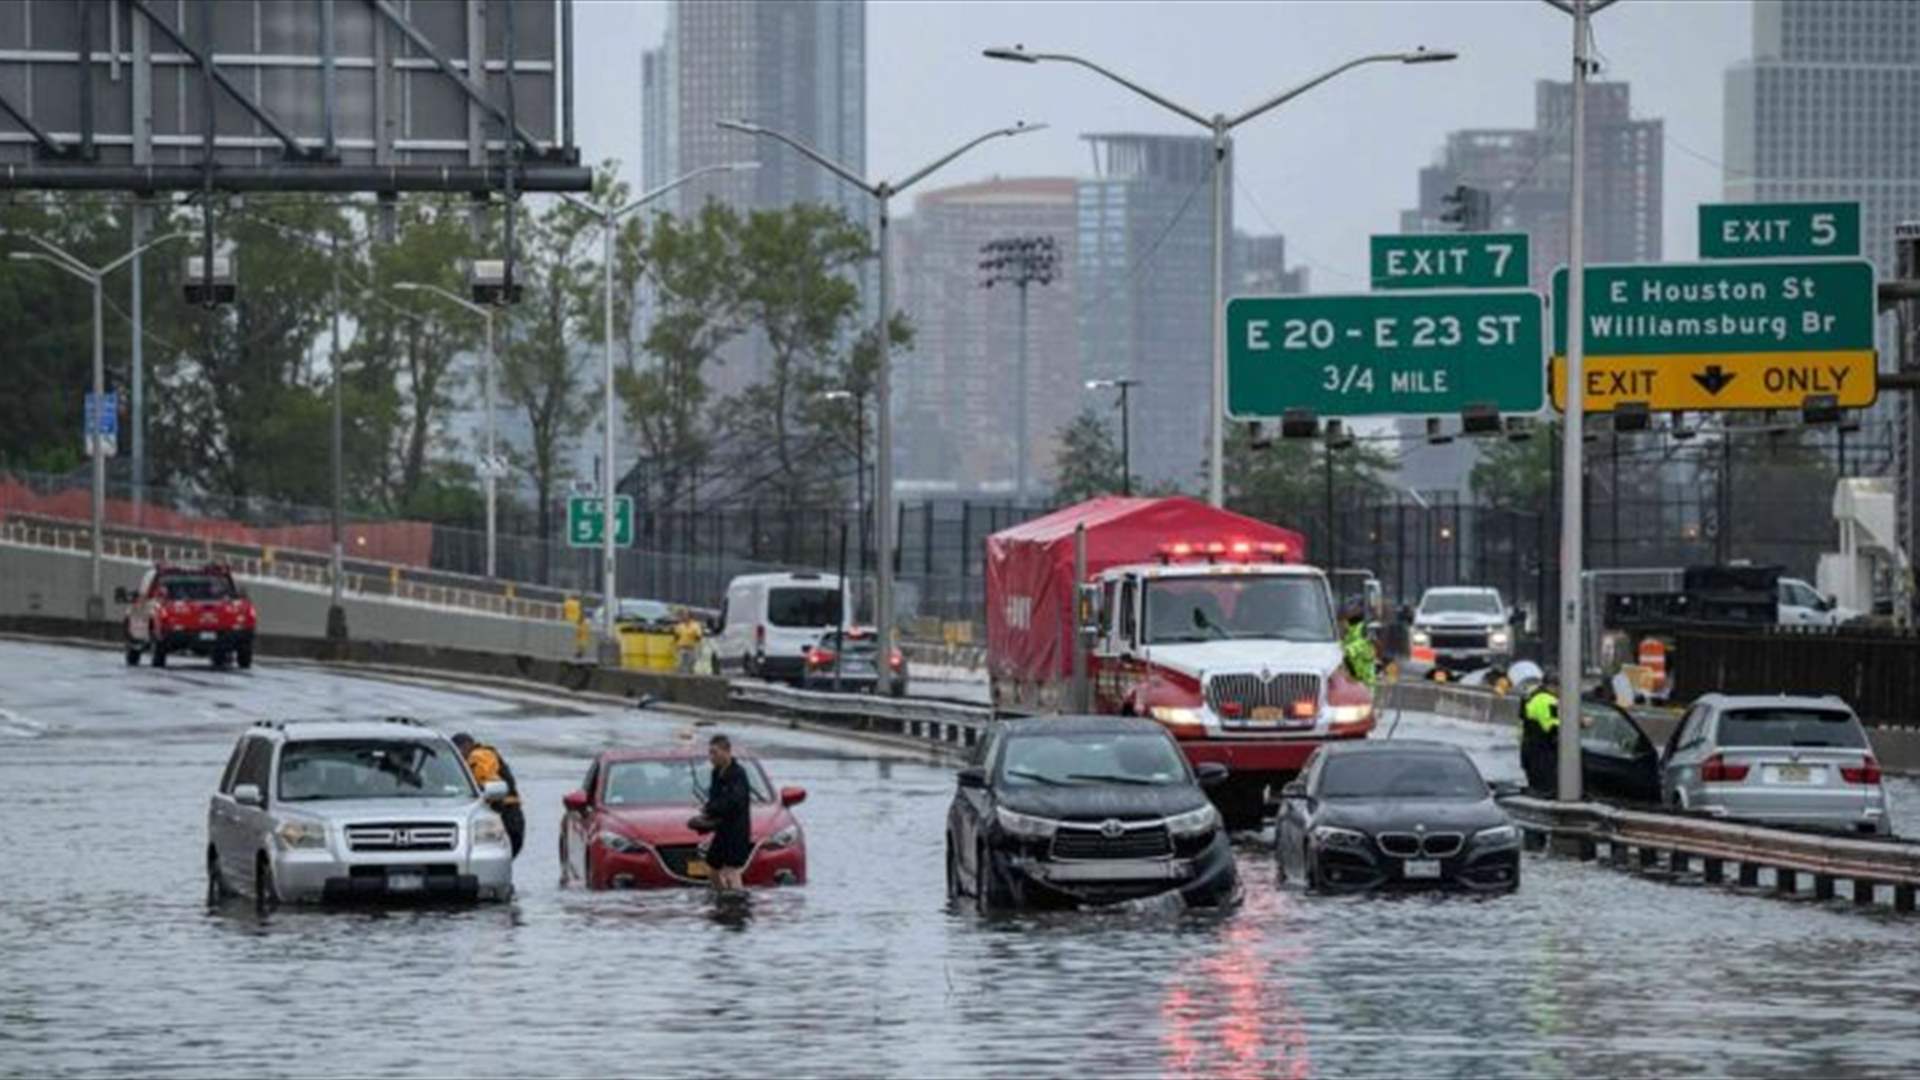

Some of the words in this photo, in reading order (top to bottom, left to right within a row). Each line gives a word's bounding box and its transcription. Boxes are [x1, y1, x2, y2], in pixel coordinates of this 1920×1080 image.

[1723, 220, 1788, 242] EXIT
[1811, 214, 1836, 245] 5
[1387, 248, 1468, 276] EXIT
[1485, 244, 1512, 277] 7
[1611, 281, 1627, 302] E
[1643, 280, 1765, 302] Houston
[1782, 276, 1813, 299] St
[1247, 320, 1269, 349] E
[1284, 319, 1334, 348] 20
[1375, 318, 1397, 347] E
[1413, 316, 1461, 346] 23
[1477, 315, 1521, 345] ST
[1590, 314, 1787, 341] Williamsburg
[1803, 311, 1835, 333] Br
[1324, 365, 1374, 393] 3/4
[1391, 370, 1447, 393] MILE
[1585, 370, 1657, 396] EXIT
[1763, 366, 1851, 393] ONLY
